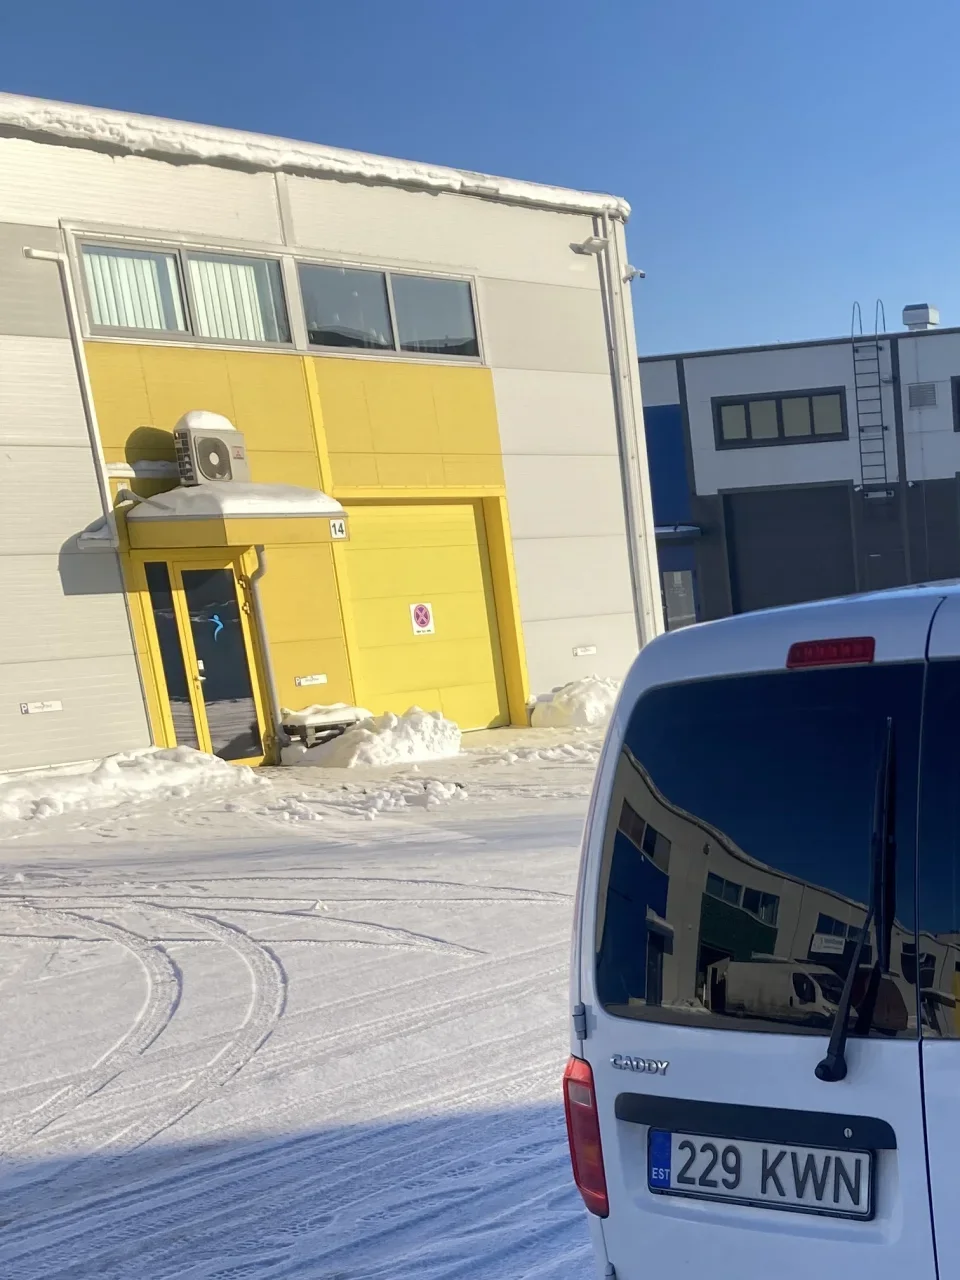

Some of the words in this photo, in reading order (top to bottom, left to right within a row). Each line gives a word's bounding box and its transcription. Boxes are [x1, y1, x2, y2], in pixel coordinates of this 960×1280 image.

[331, 522, 345, 536] 14
[610, 1053, 670, 1076] CADDY
[652, 1167, 671, 1181] EST
[676, 1140, 742, 1190] 229
[760, 1148, 862, 1206] KWN
